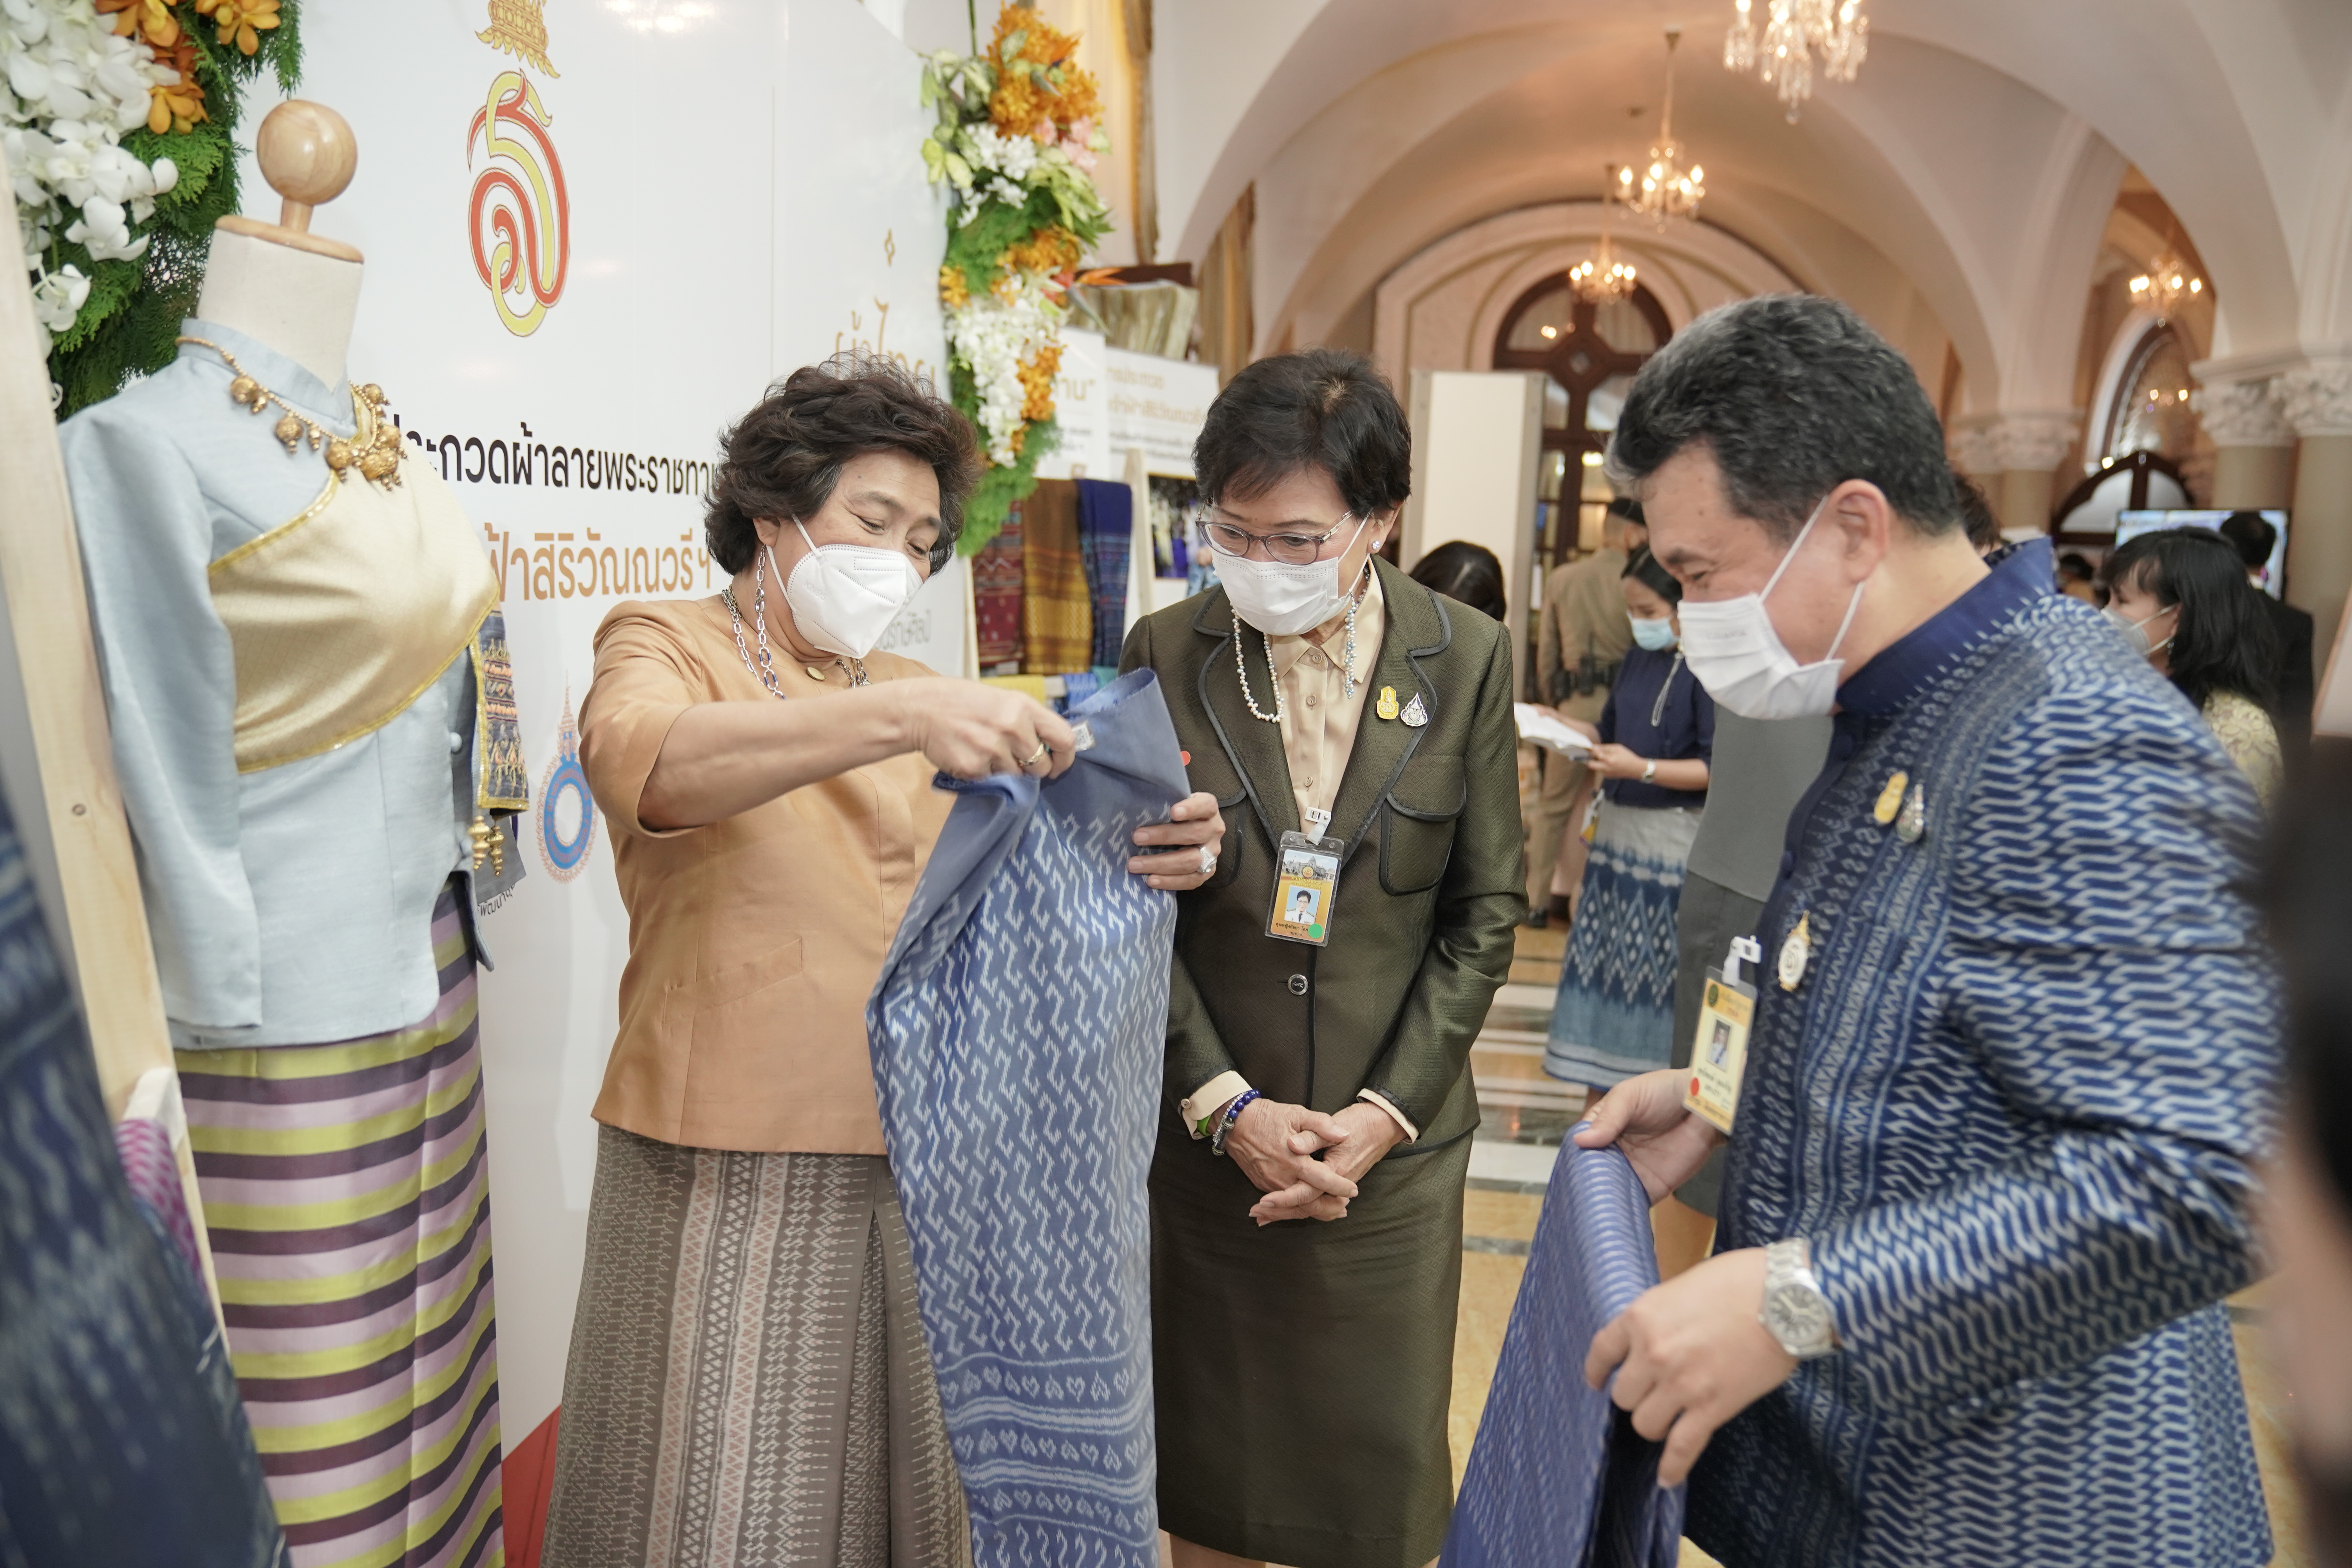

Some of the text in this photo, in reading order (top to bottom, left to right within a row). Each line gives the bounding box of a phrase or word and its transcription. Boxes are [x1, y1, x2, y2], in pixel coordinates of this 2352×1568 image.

[394, 414, 714, 495] ะกวดผ้าลายพระราชทา
